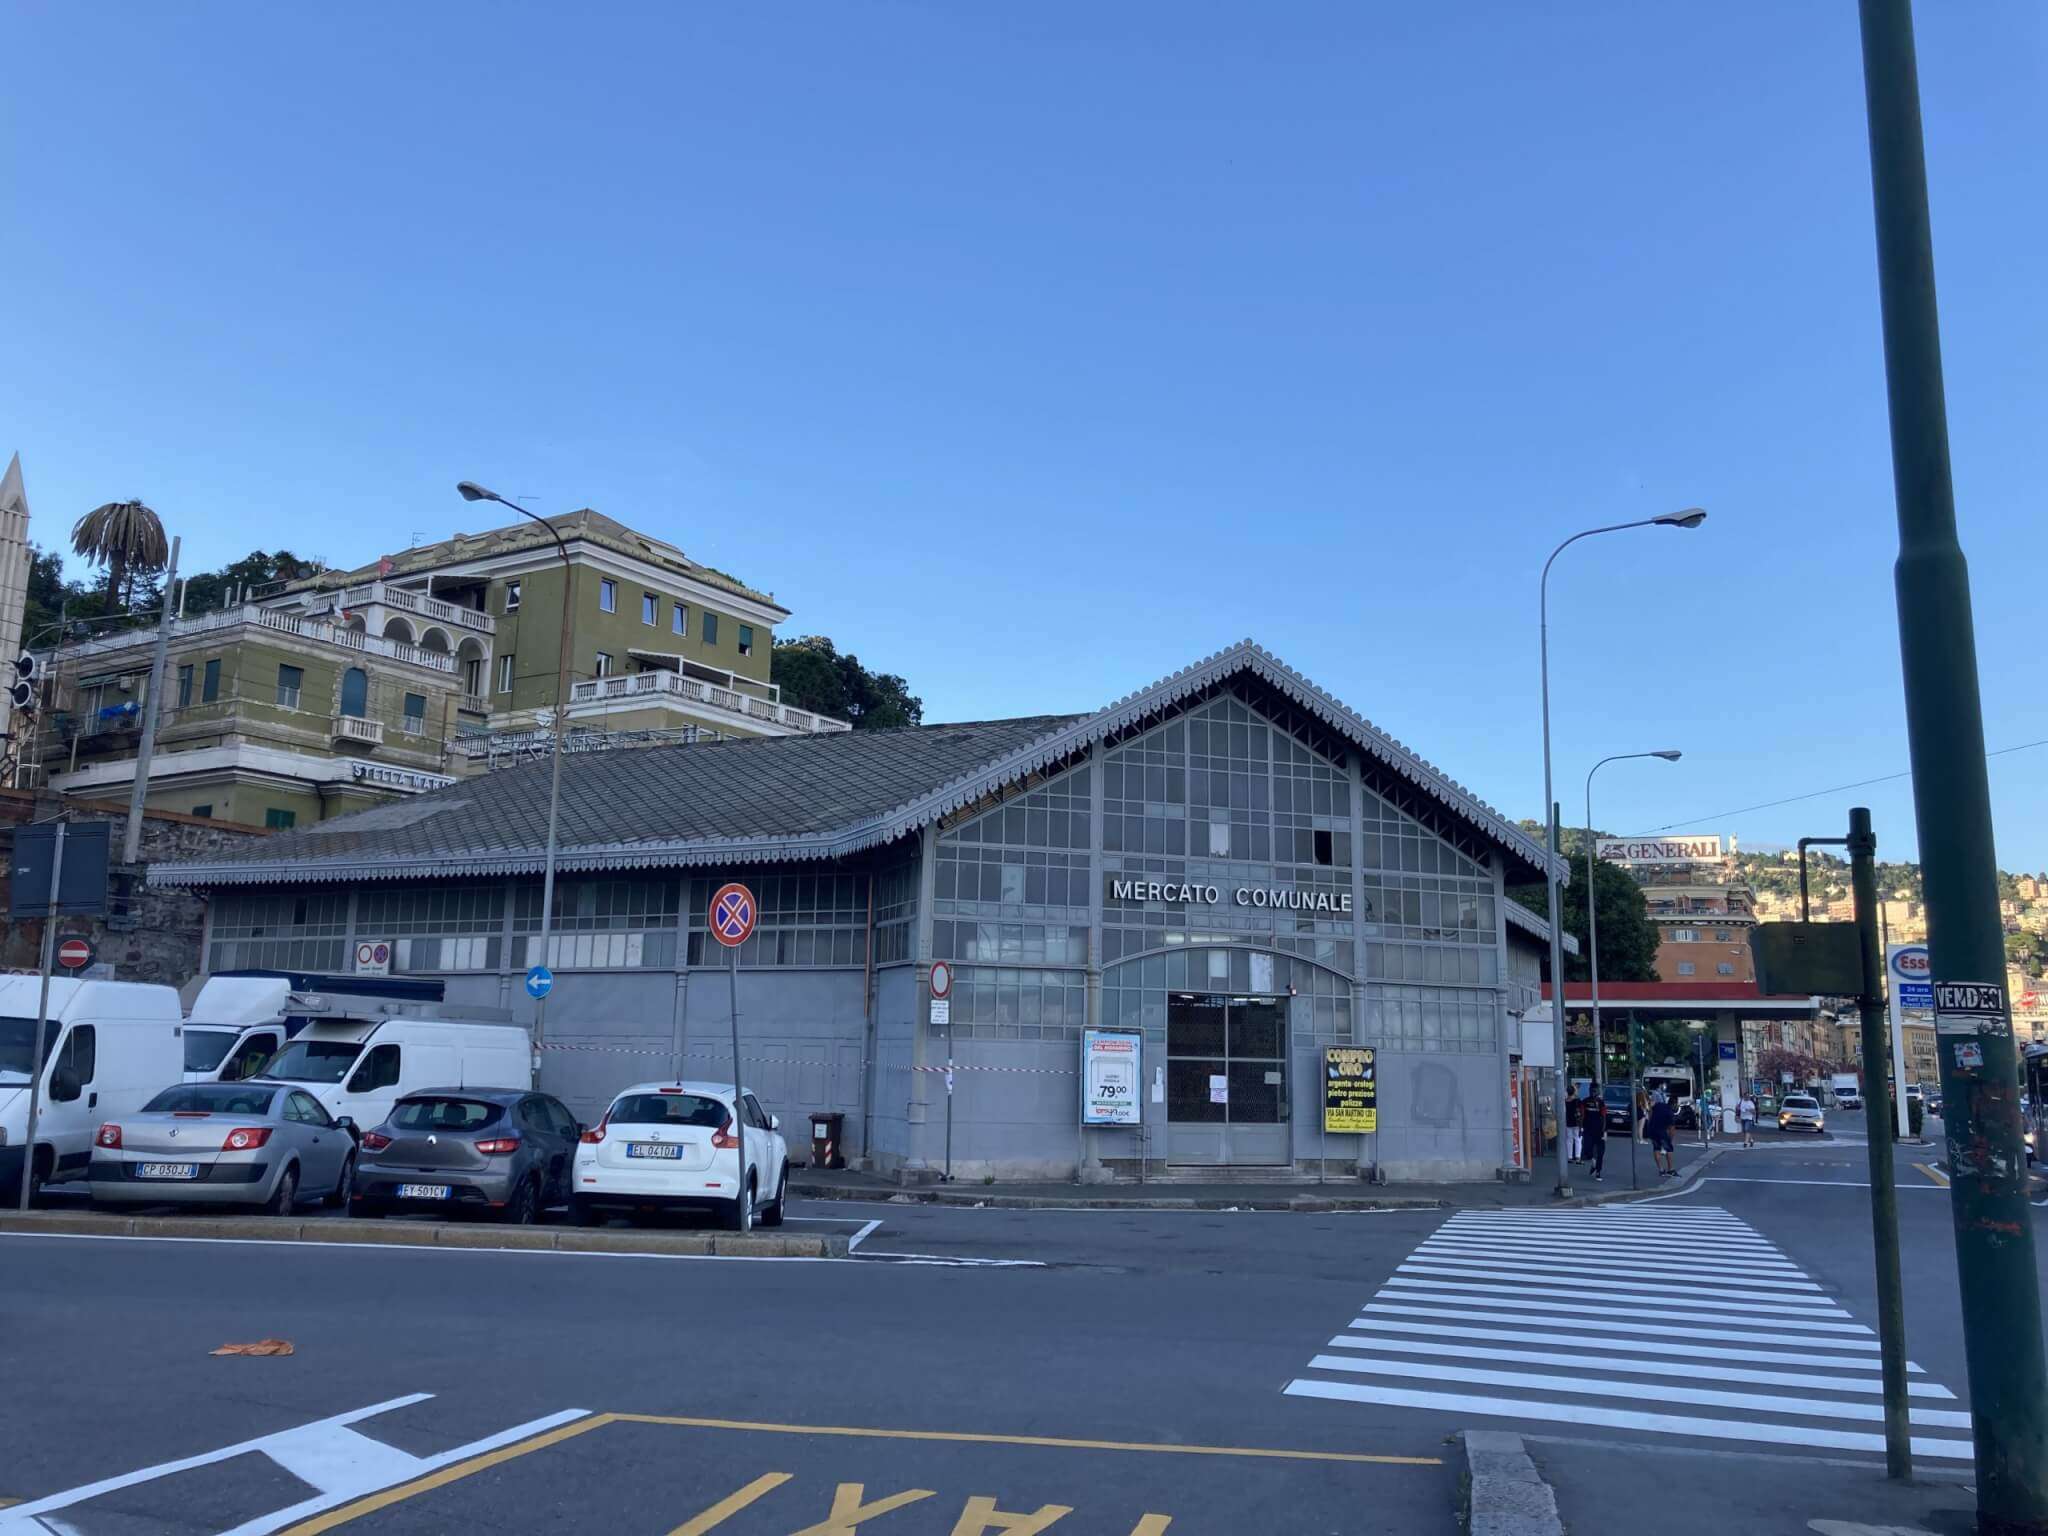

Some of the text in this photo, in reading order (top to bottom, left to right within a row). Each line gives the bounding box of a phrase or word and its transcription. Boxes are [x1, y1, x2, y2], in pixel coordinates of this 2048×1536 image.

[352, 763, 406, 785] STELLA
[1627, 841, 1717, 859] GENERALI
[1112, 879, 1353, 912] MERCATO COMUNALE
[1900, 955, 1930, 970] Ess
[1936, 986, 2003, 1010] VENDESI
[1327, 1048, 1374, 1064] COMPRO
[1338, 1062, 1363, 1076] ORO
[633, 1144, 644, 1156] EL
[143, 1164, 157, 1175] CP
